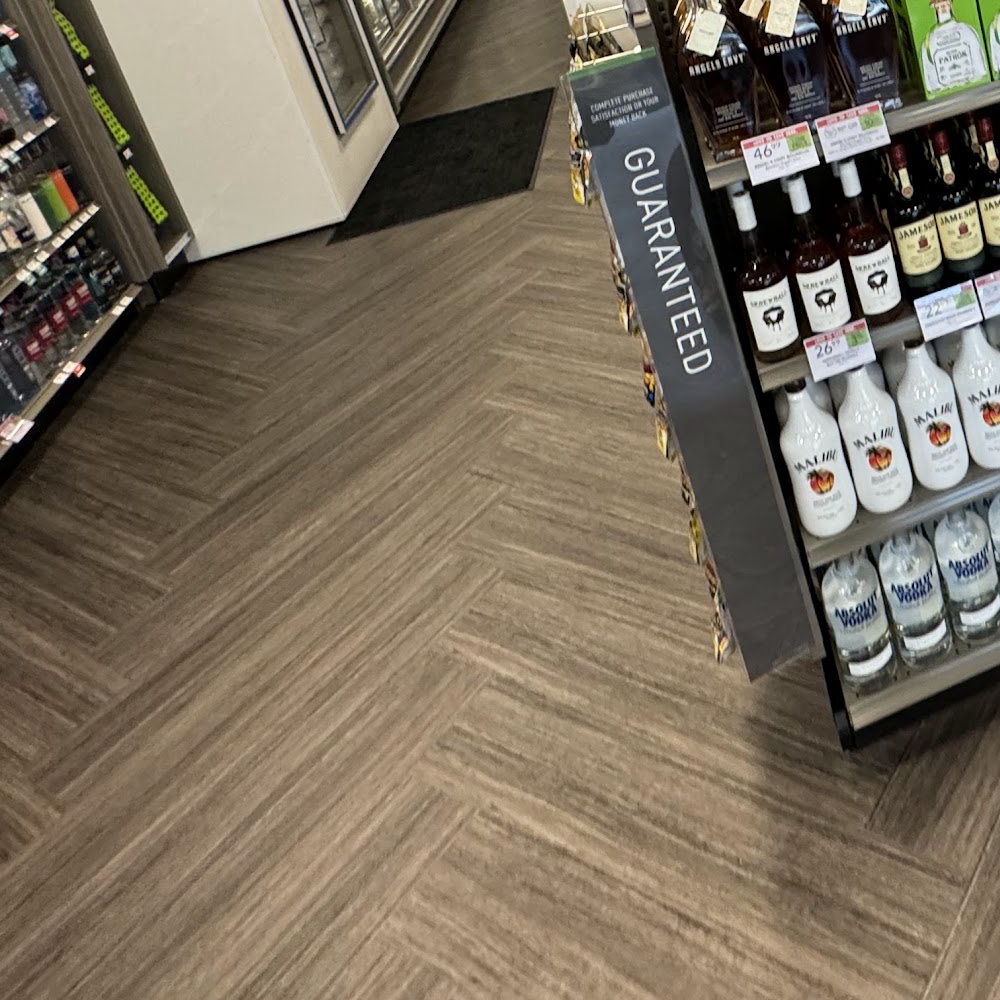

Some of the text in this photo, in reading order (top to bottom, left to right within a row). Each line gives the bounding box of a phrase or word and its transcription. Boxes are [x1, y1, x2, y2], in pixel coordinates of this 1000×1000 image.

[868, 14, 889, 28] ENVY
[797, 33, 818, 48] ENVY
[723, 53, 745, 68] ENVY
[590, 87, 653, 112] COMPLETE PURCHASE
[591, 96, 659, 124] SATISFACTION OR YOUR
[609, 111, 647, 128] MONEY BACK
[624, 147, 713, 375] GUARANTEED
[949, 543, 989, 568] ABSOLUT
[954, 558, 989, 579] VODKA
[891, 568, 933, 593] ABSOLUT
[835, 589, 877, 618] ABSOLUT
[896, 583, 933, 604] VODKA
[840, 605, 877, 628] VODKA
